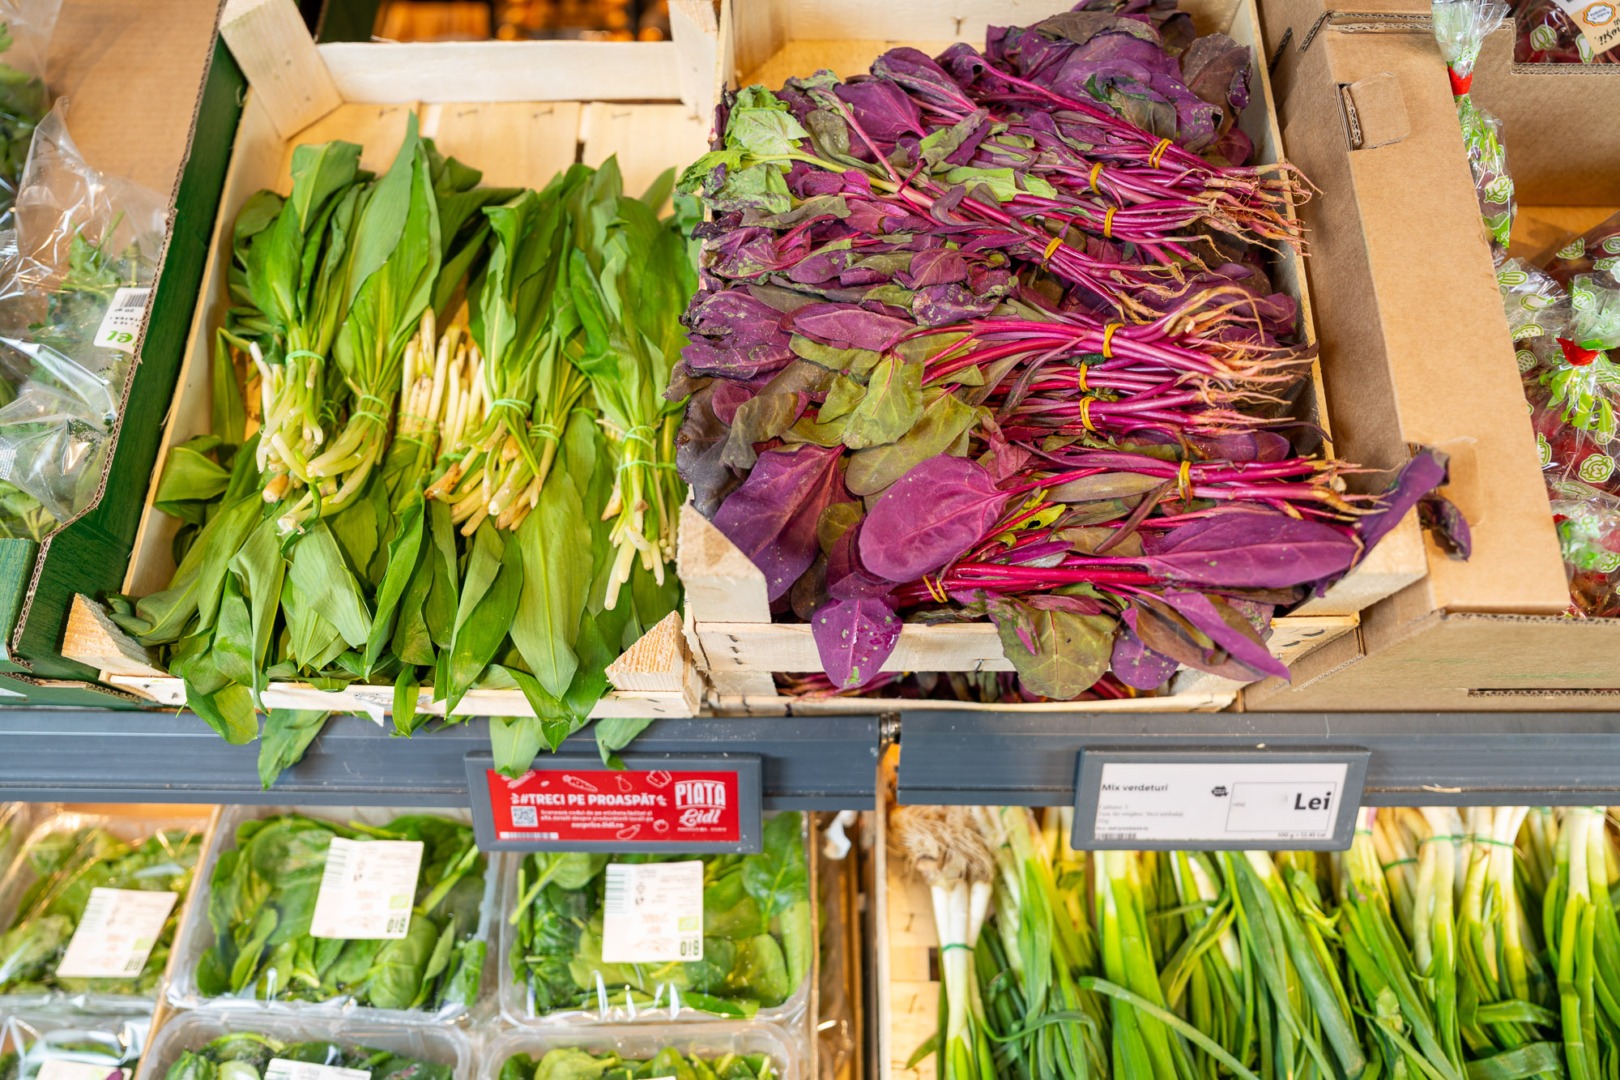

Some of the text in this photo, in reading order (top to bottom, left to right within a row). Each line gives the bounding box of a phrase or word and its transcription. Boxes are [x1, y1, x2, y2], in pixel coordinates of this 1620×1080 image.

[1101, 783, 1169, 792] Mix verdeturi
[567, 794, 586, 806] PE
[587, 792, 656, 806] PROASPĂT
[1294, 791, 1332, 810] Lei
[679, 808, 722, 827] Lidl
